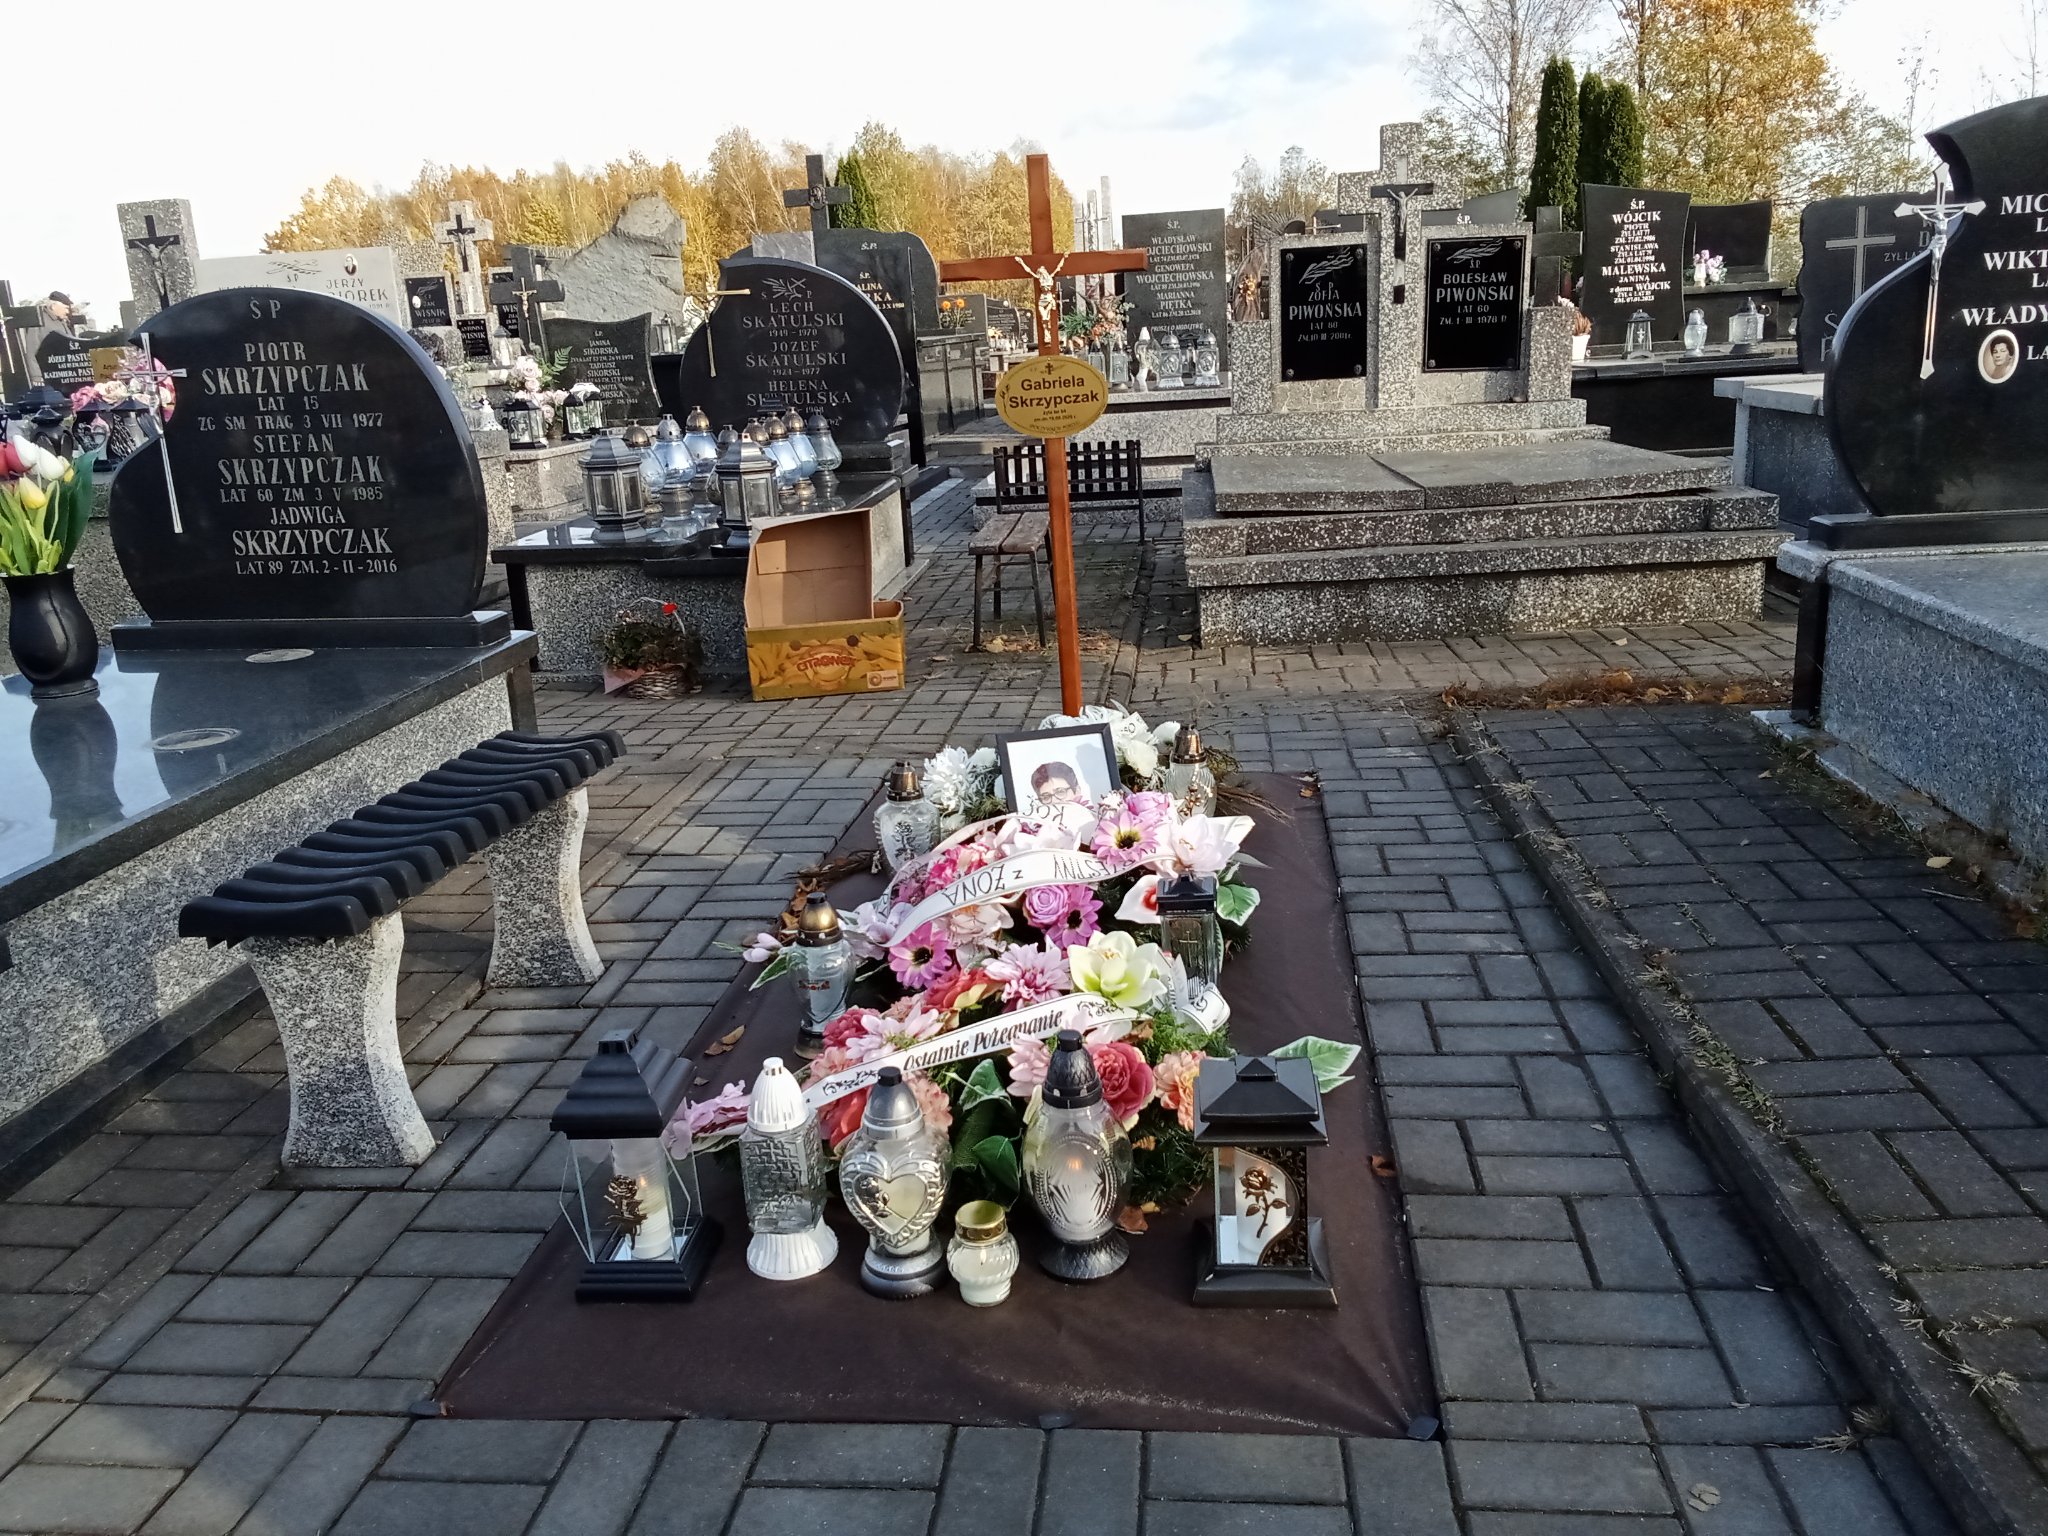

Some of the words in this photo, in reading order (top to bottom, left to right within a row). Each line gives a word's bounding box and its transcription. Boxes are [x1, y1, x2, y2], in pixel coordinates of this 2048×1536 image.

[1457, 213, 1472, 225] Ś.P.
[1612, 211, 1662, 224] WÓJCIK
[1624, 223, 1649, 231] PIOTR
[1146, 242, 1212, 256] OJCIECHOWSKI
[1155, 263, 1195, 273] GENOWEFA
[1602, 263, 1666, 276] MALEWSKA
[1136, 271, 1215, 284] WOJCIECHOWSKA
[1443, 272, 1507, 285] BOLESŁAW
[1619, 275, 1650, 283] JANINA
[1636, 280, 1671, 291] WÓJCIK
[1156, 290, 1195, 300] MARIANNA
[1436, 285, 1514, 303] PIWOŃSKI
[769, 301, 814, 314] LECH
[1289, 301, 1362, 320] PIWOŃSKA
[742, 312, 844, 329] SKATULSKI
[589, 339, 611, 347] JANINA
[244, 341, 307, 362] PIOTR
[583, 346, 619, 355] SIKORSKA
[43, 370, 77, 379] KAZIMIERA
[201, 363, 370, 395] SKRZYPCZAK
[587, 368, 621, 377] SIKORSKI
[768, 379, 828, 391] HELENA
[1021, 375, 1085, 391] Gabriela
[600, 390, 624, 399] ORSKA
[1009, 390, 1100, 409] Skrzypczak
[257, 396, 285, 411] LAT
[303, 396, 319, 411] 15
[198, 416, 216, 431] ZG
[303, 414, 311, 428] 3
[321, 413, 343, 428] VII
[352, 412, 383, 428] 1977
[253, 433, 334, 453] STEFAN
[217, 455, 385, 485] SKRZYPCZAK
[220, 488, 247, 503] LAT
[257, 487, 273, 502] 60
[282, 487, 305, 502] ZM
[315, 487, 322, 501] 3
[333, 487, 342, 501] V
[352, 486, 383, 501] 1985
[270, 505, 346, 525] JADWIGA
[232, 527, 393, 556] SKRZYPCZAK
[235, 560, 265, 574] LAT
[268, 560, 283, 574] 89
[290, 560, 319, 574] ZM.
[903, 1040, 969, 1071] Ostatnie
[974, 1009, 1064, 1053] Pożegnanie
